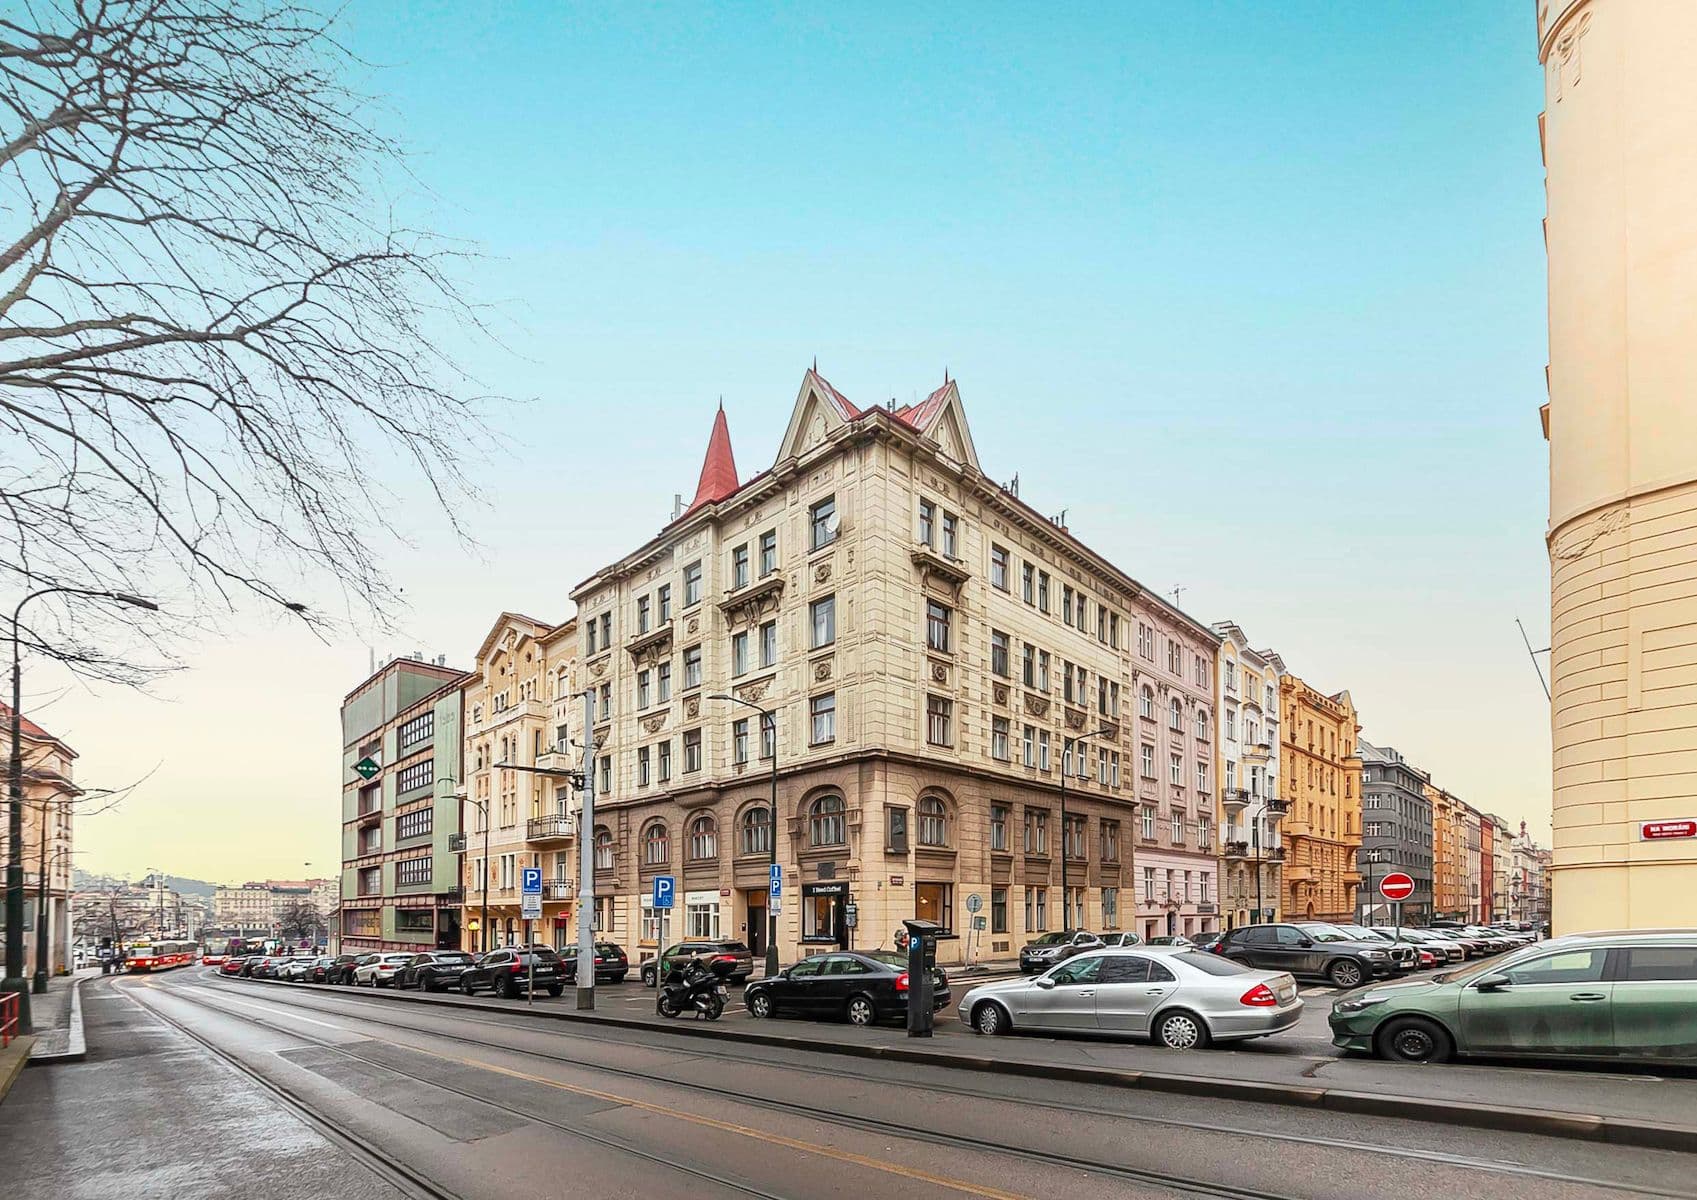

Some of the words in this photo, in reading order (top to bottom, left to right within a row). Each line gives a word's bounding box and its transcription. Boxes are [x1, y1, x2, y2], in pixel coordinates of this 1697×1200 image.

[526, 870, 538, 886] P
[658, 879, 671, 899] P
[772, 880, 780, 892] P
[911, 937, 918, 949] P
